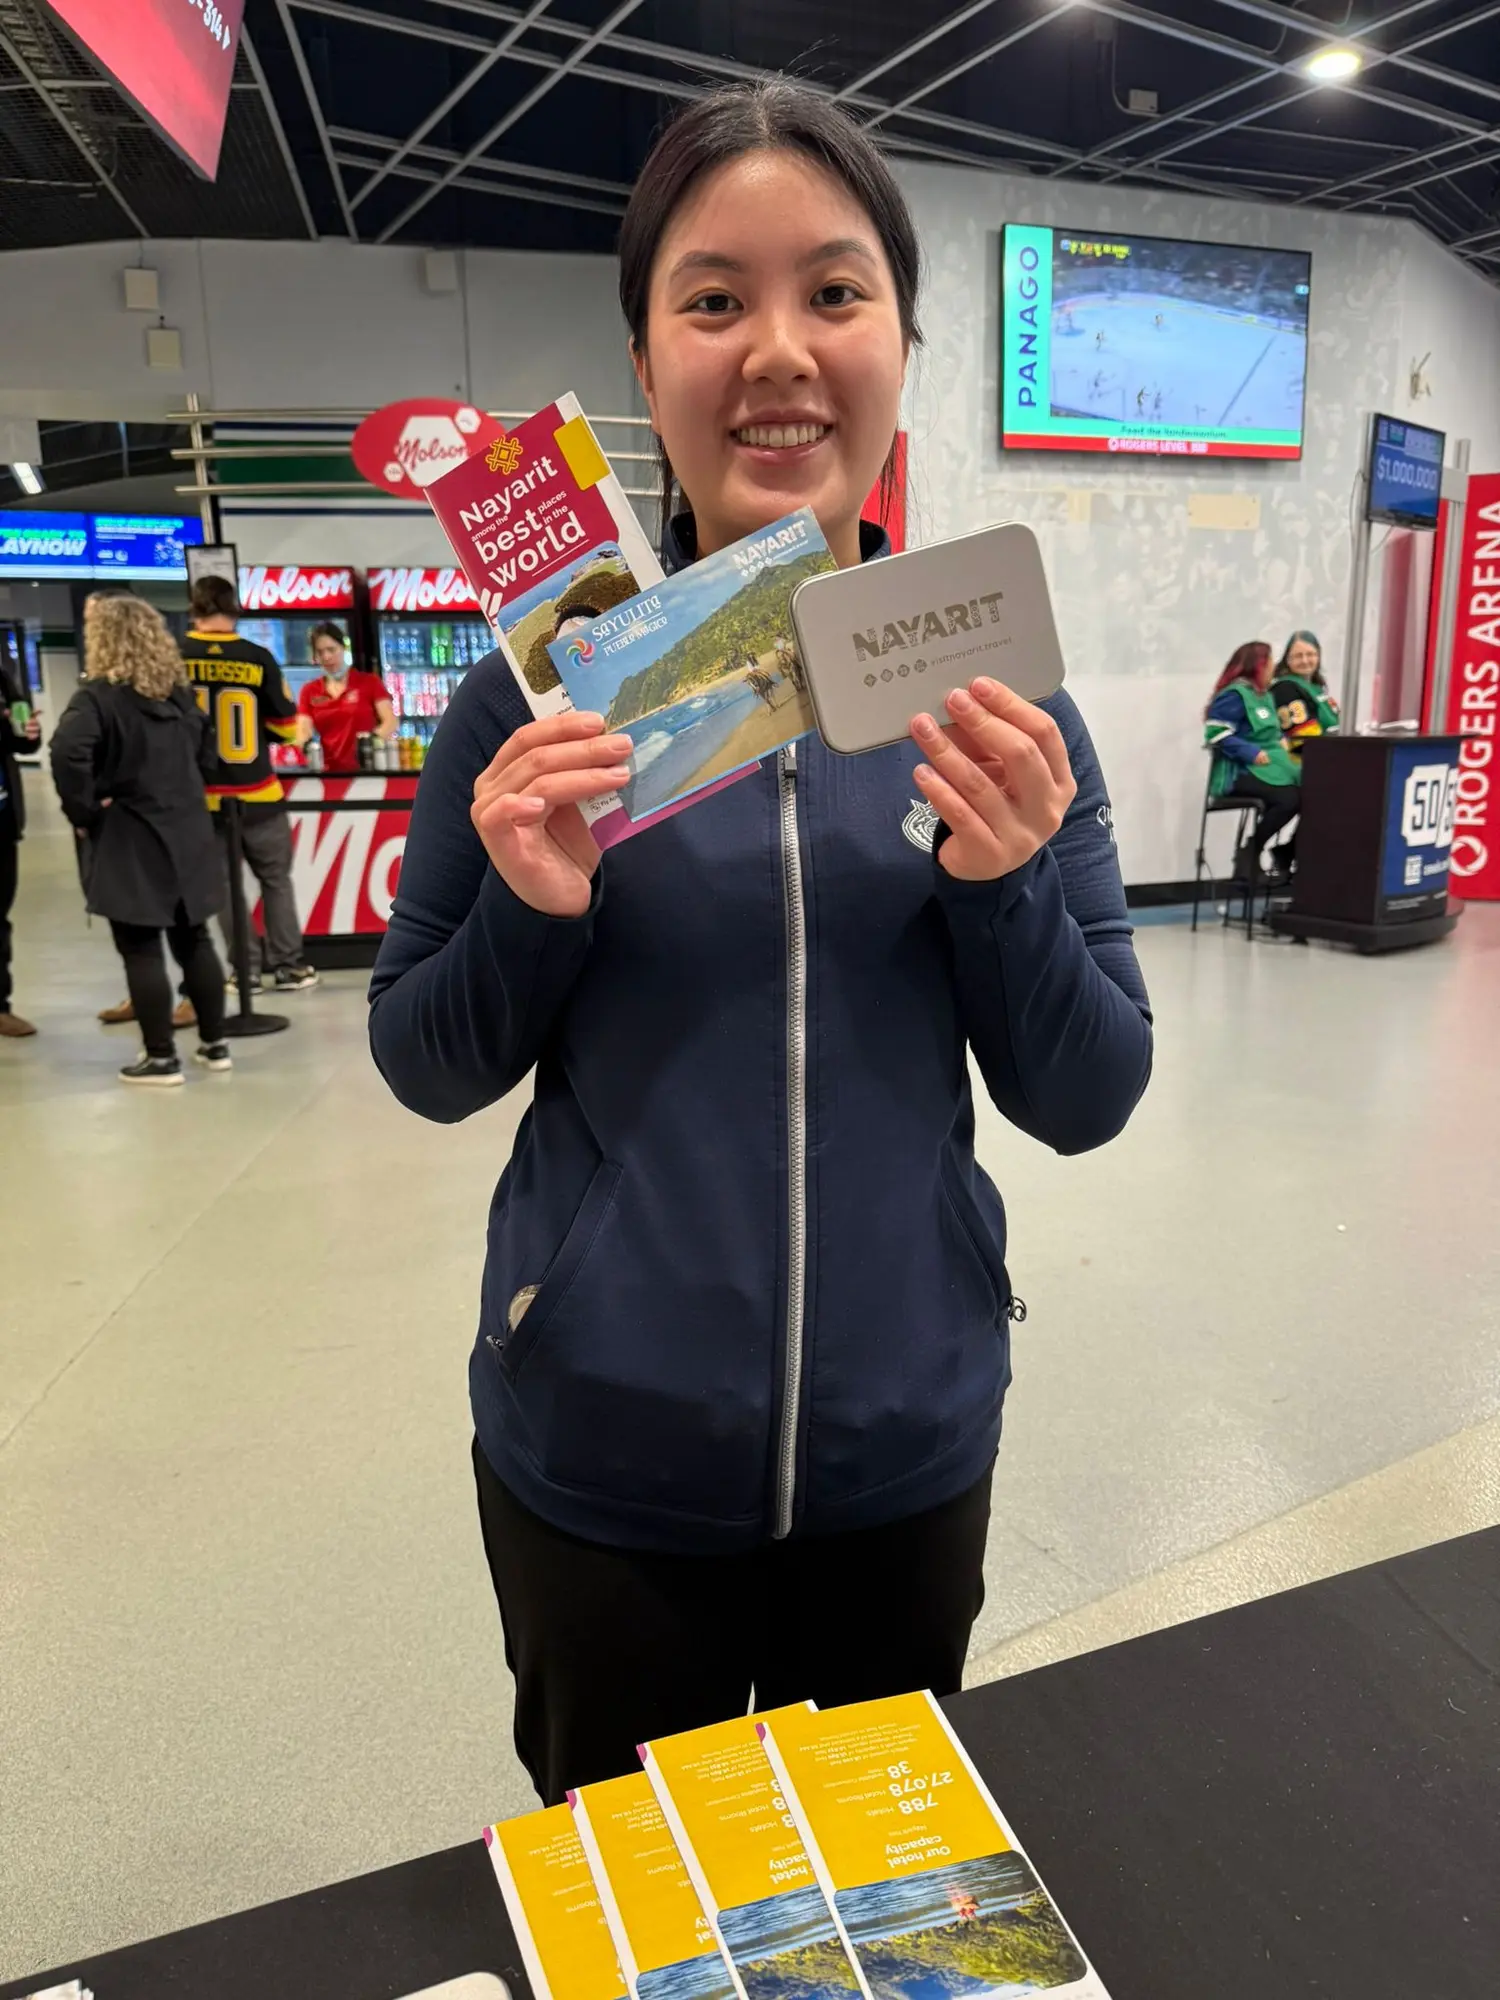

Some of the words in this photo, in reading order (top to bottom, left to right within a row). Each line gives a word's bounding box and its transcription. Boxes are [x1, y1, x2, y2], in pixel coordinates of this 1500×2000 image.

[1018, 246, 1039, 408] PANAGO
[1376, 453, 1438, 490] $1,000,000
[459, 456, 558, 532] Nayarit
[537, 490, 567, 514] places
[543, 516, 553, 525] in
[552, 505, 568, 519] the
[471, 524, 496, 543] among
[495, 515, 509, 527] the
[474, 508, 543, 565] best
[488, 510, 586, 588] world
[732, 520, 807, 570] NAYARIT
[237, 566, 353, 610] Molson
[367, 568, 477, 611] Mols
[852, 591, 1003, 662] NAYARIT
[1454, 660, 1500, 826] ROGERS
[887, 1760, 912, 1779] 38
[863, 1790, 886, 1799] Hotel
[888, 1771, 954, 1797] 27,078
[748, 1805, 769, 1815] Hotel
[866, 1807, 894, 1816] Hotels
[898, 1792, 939, 1815] 788
[749, 1821, 778, 1833] Hotels
[885, 1835, 942, 1855] capacity
[926, 1845, 951, 1858] Our
[647, 1863, 677, 1875] Rooms
[886, 1852, 925, 1868] hotel
[769, 1864, 808, 1884] hotel
